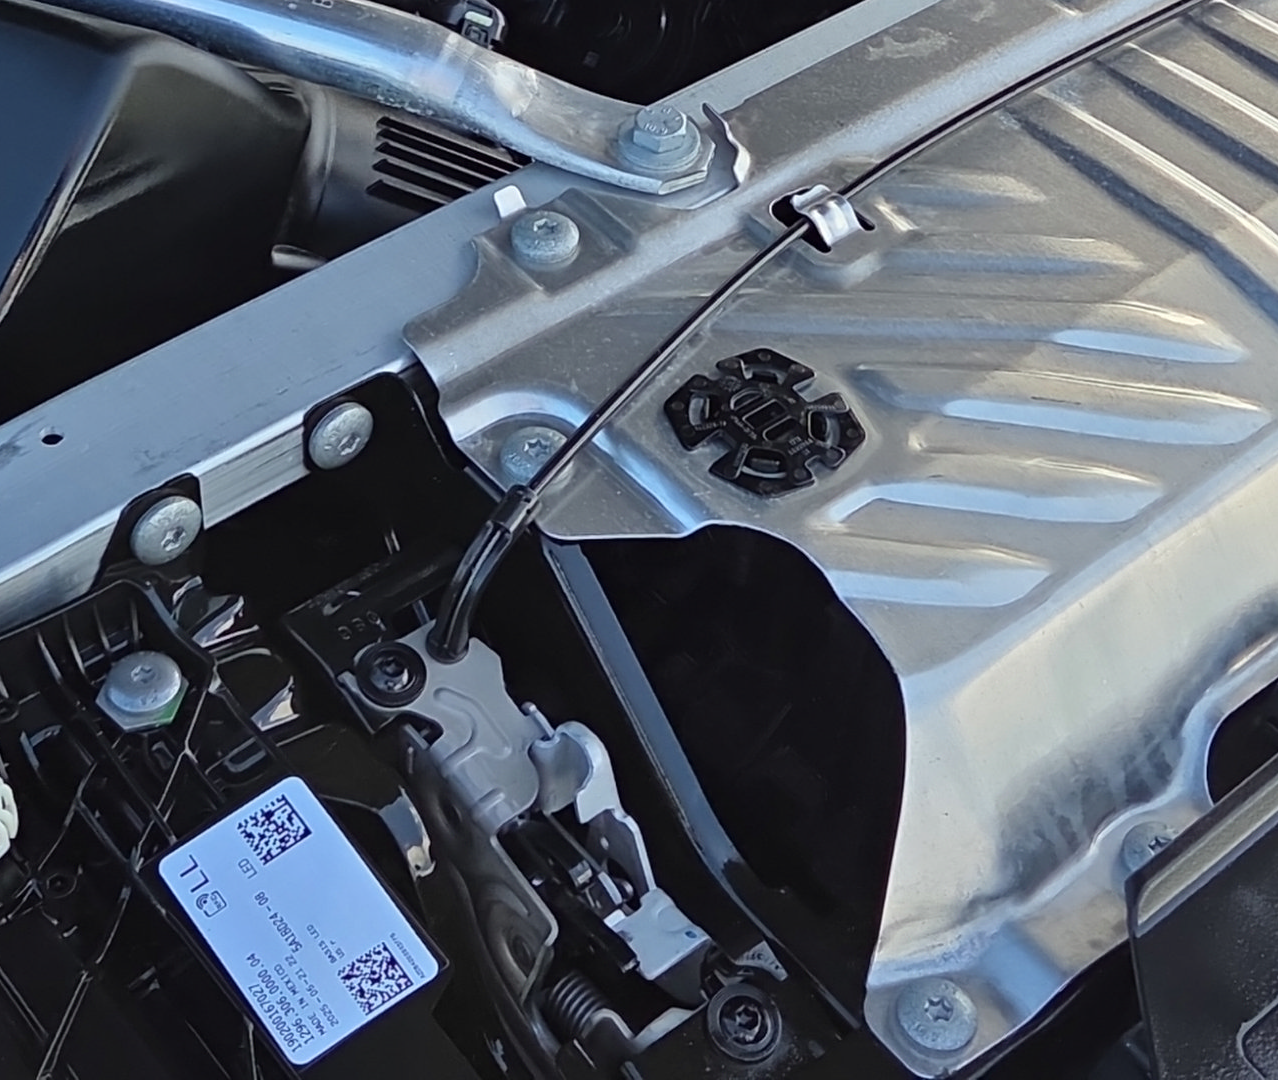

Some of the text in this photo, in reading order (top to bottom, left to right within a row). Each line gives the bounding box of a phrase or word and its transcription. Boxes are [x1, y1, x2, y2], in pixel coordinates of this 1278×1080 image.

[179, 854, 209, 892] LL
[237, 857, 257, 879] LED
[306, 924, 337, 963] BASIS LED
[246, 952, 314, 1044] 1296.306.0000.04
[247, 983, 302, 1052] 190200167027
[273, 963, 325, 1035] MADE IN MEXICO
